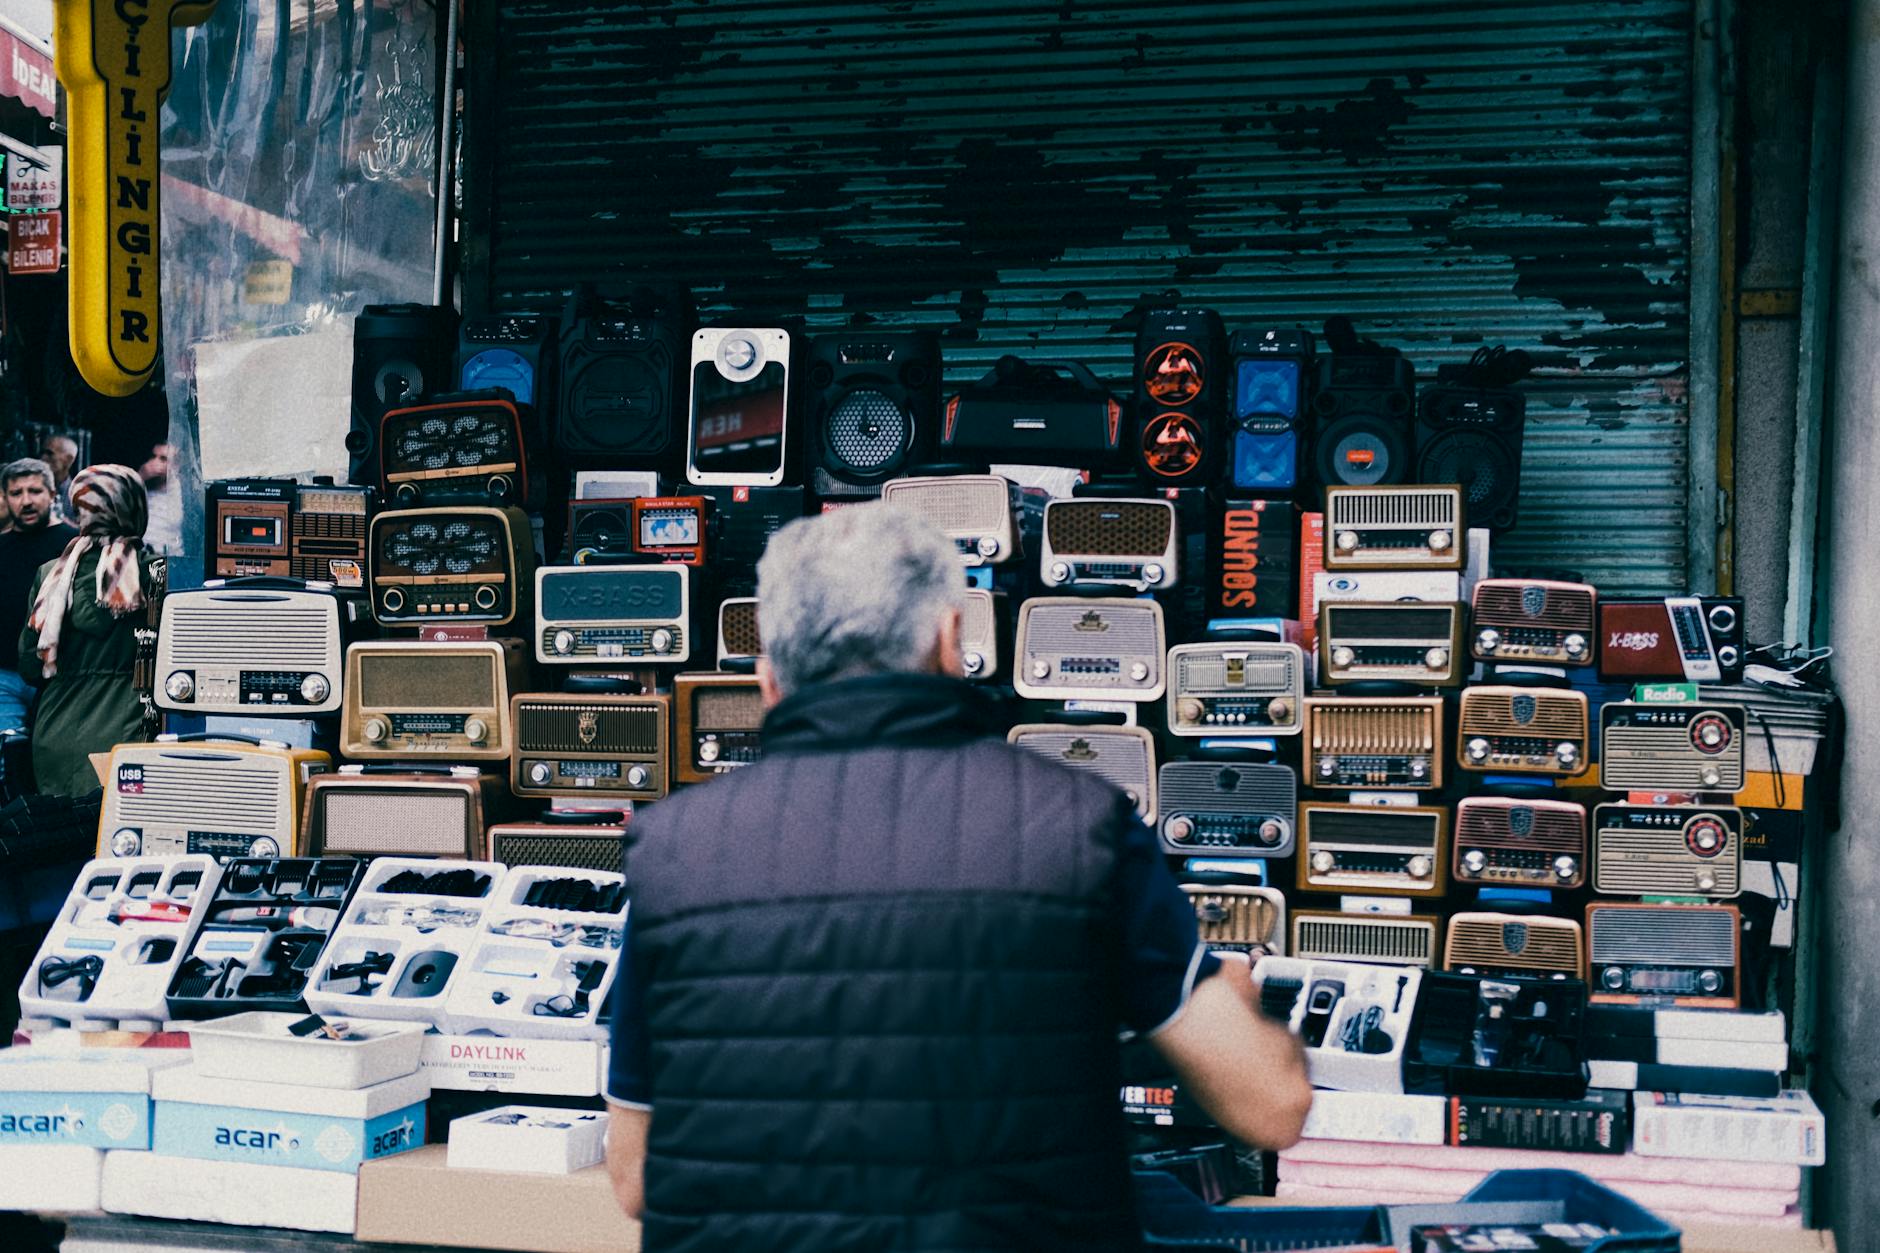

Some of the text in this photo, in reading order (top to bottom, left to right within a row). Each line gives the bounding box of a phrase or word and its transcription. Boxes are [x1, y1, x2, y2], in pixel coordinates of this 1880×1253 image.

[10, 181, 56, 191] MAKAS
[1222, 510, 1259, 608] SOUND
[560, 585, 664, 607] X-BASS
[1643, 687, 1686, 701] Radio
[119, 769, 142, 780] USB
[450, 1044, 527, 1061] DAYLINK
[0, 1115, 66, 1132] acar
[215, 1127, 281, 1149] acar
[373, 1128, 407, 1153] acar
